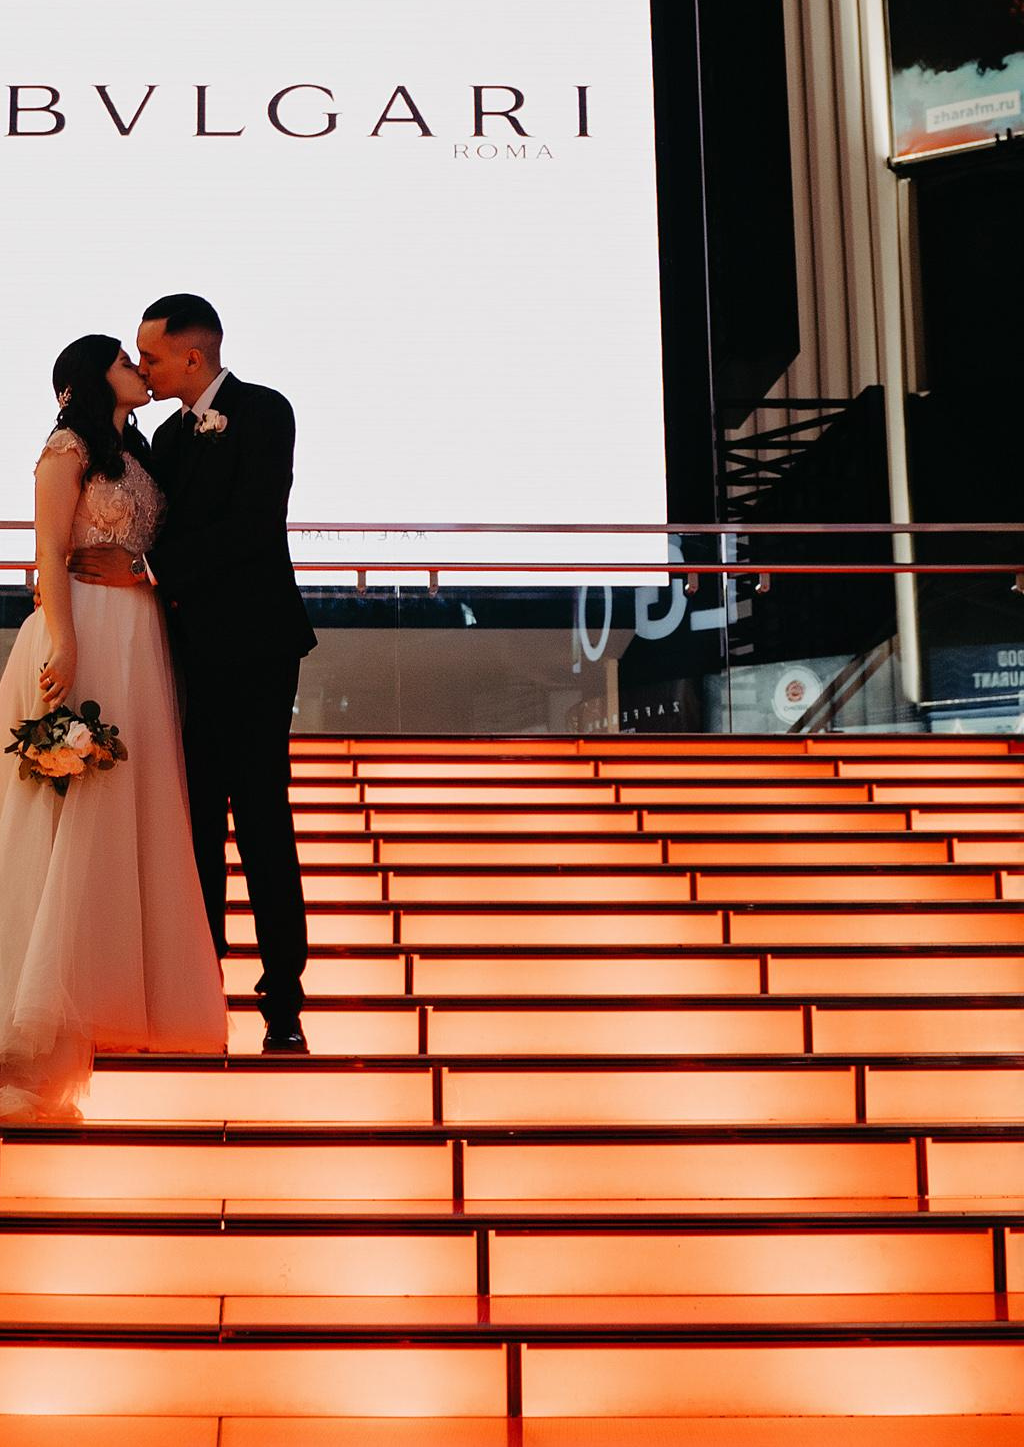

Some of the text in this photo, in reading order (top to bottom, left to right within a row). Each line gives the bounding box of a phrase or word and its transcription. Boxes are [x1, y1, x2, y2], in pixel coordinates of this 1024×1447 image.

[4, 83, 594, 138] BVLGARI
[932, 94, 1017, 126] zharafm.ru
[452, 143, 556, 160] ROMA
